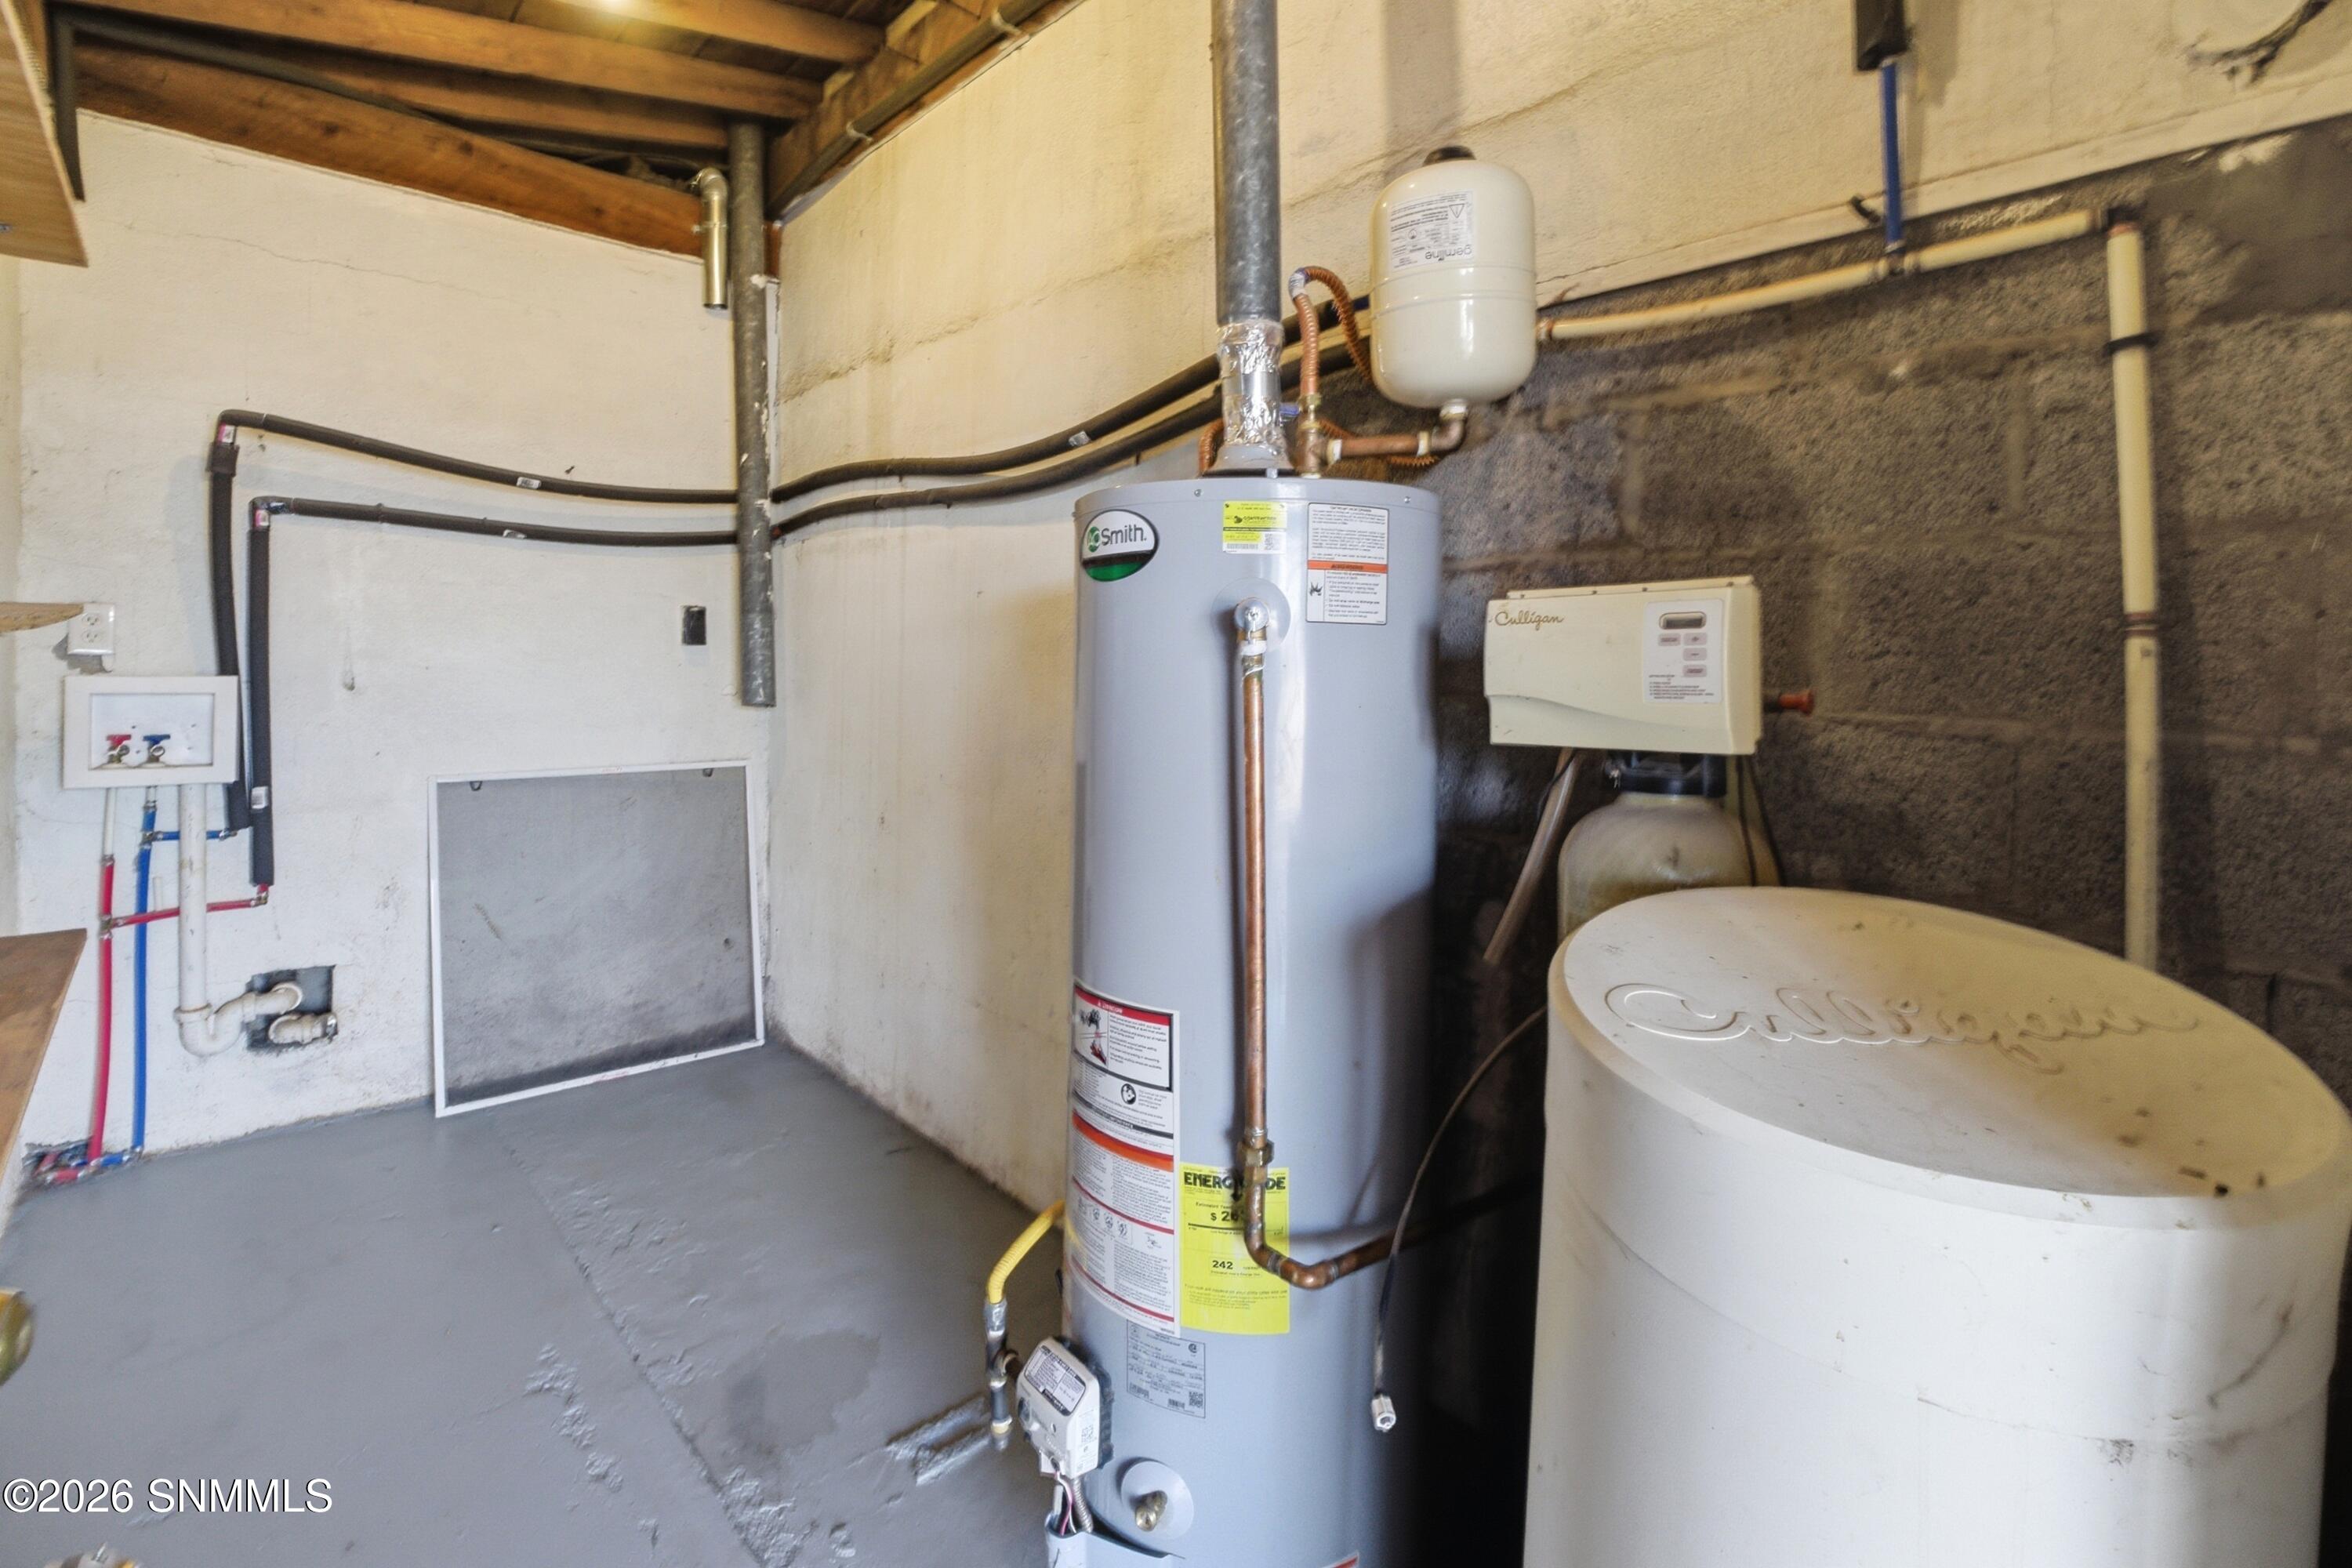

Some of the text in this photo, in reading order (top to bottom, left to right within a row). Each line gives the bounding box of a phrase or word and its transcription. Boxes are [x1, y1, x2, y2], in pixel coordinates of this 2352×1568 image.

[1494, 612, 1565, 631] Culligan
[1604, 982, 2201, 1075] Culligan
[1212, 1260, 1233, 1270] 242
